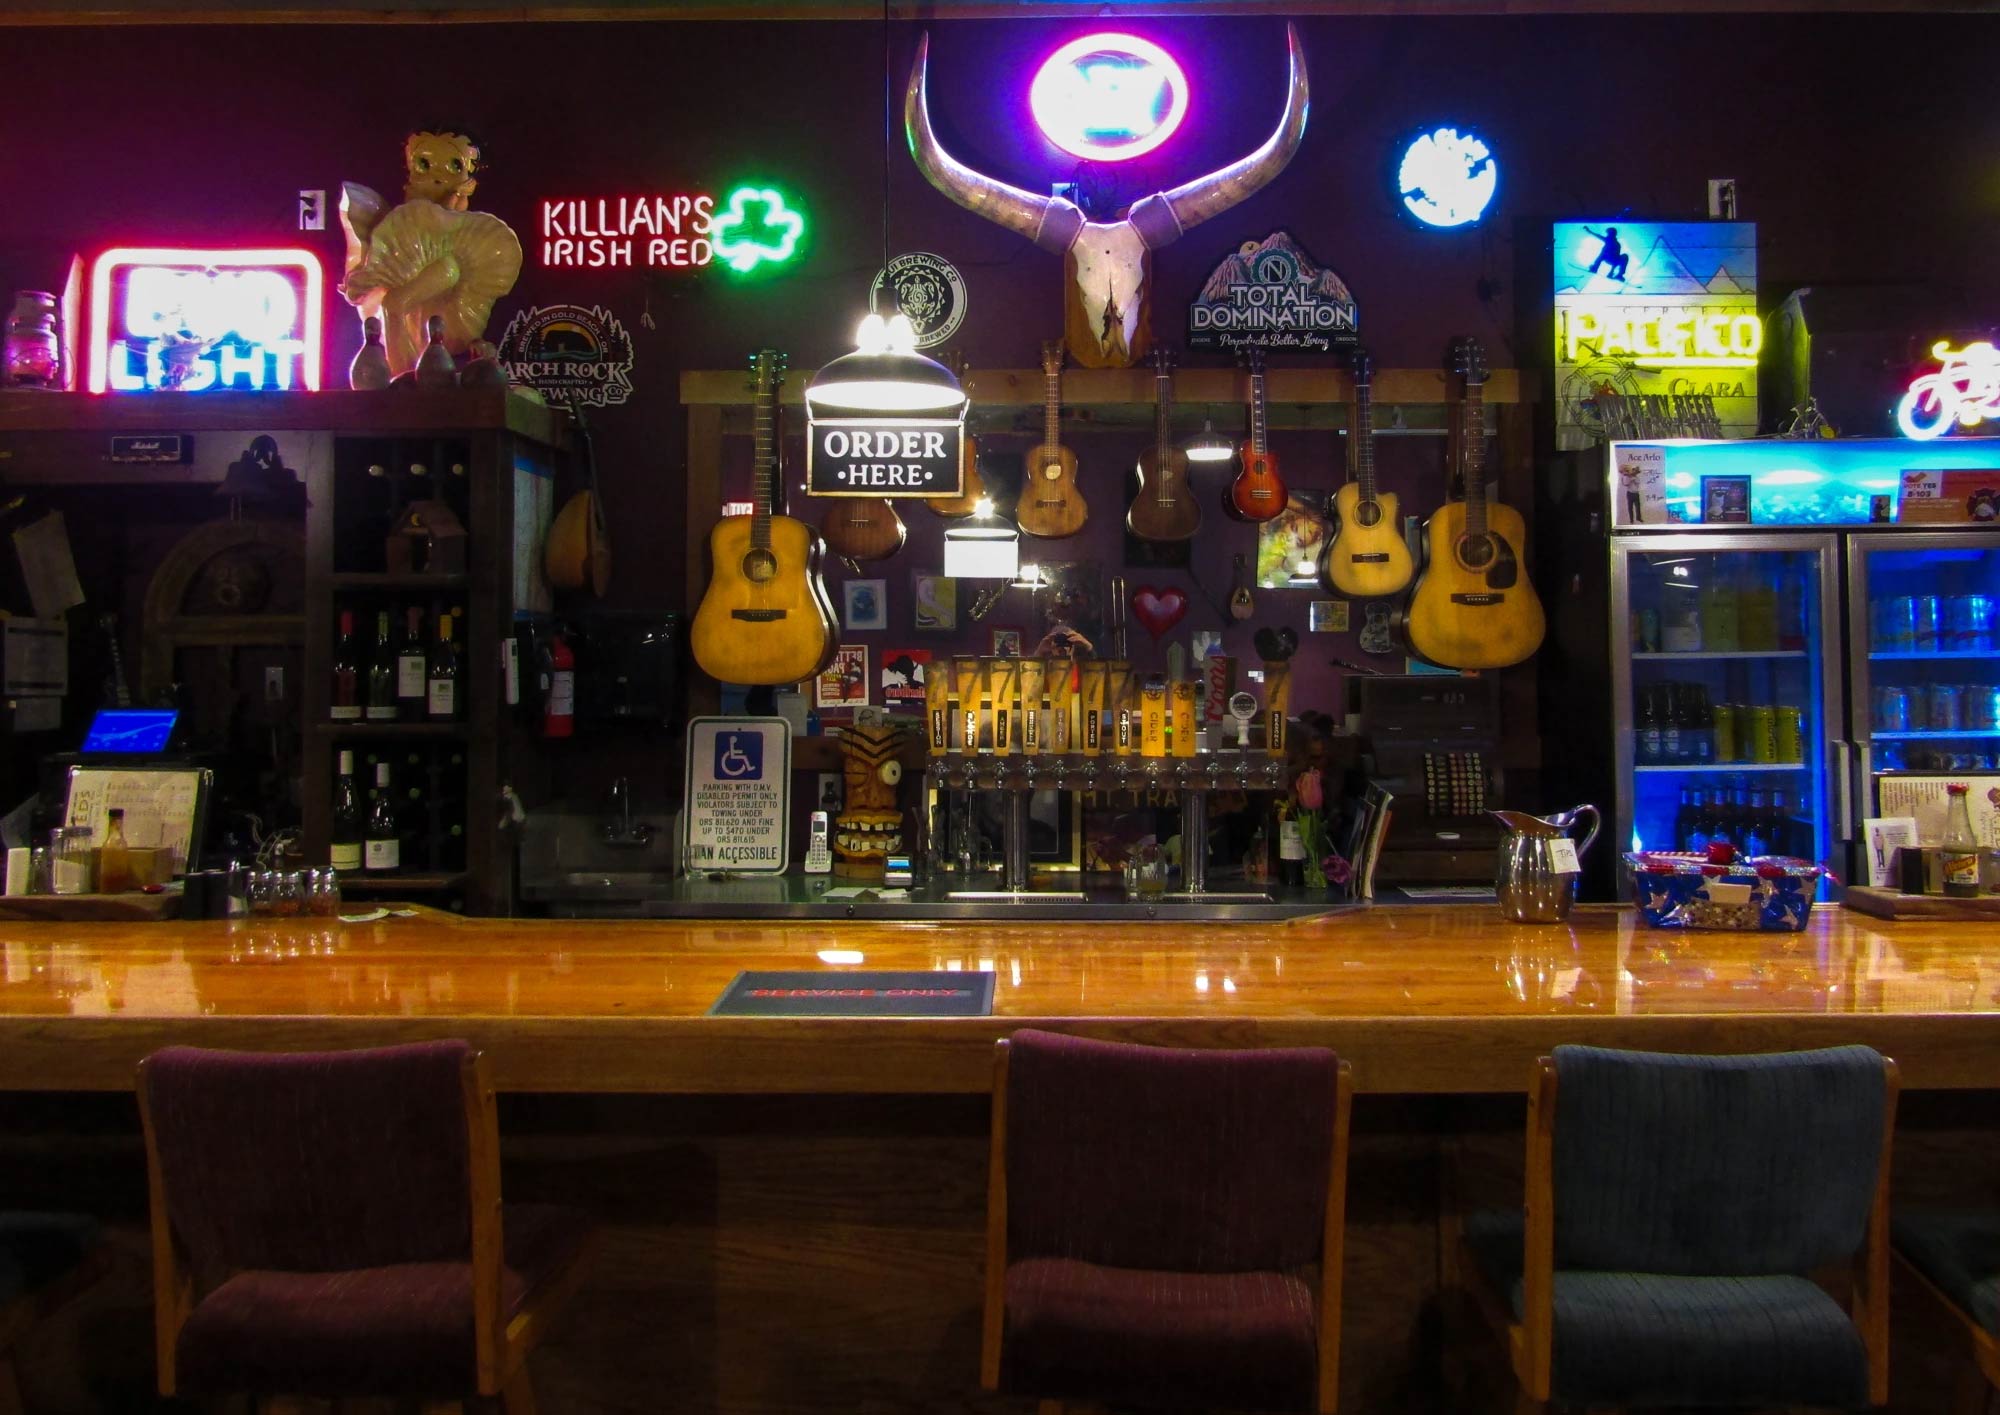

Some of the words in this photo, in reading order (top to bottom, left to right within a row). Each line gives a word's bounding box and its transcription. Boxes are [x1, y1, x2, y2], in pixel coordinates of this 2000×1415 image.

[543, 195, 714, 237] KILLIAN'S
[543, 239, 633, 267] IRISH
[648, 239, 713, 267] RED
[899, 256, 946, 272] BREWING
[1230, 285, 1317, 306] TOTAL
[542, 314, 551, 324] IN
[551, 310, 576, 320] GOLD
[1192, 305, 1354, 328] DOMINATION
[919, 324, 952, 344] BREWED
[1270, 333, 1300, 347] Better
[503, 361, 560, 382] ARCH
[564, 361, 626, 384] ROCK
[823, 430, 947, 458] ORDER
[848, 464, 923, 486] HERE
[1088, 714, 1096, 744] PORTER
[1120, 712, 1129, 744] STOUT
[1150, 711, 1159, 742] CIDER
[703, 783, 733, 791] PARKING
[735, 783, 751, 791] WITH
[697, 792, 730, 800] DISABLED
[732, 792, 757, 800] PERMIT
[759, 792, 778, 800] ONLY
[697, 801, 735, 809] VIOLATORS
[736, 801, 767, 809] SUBJECT
[712, 809, 737, 817] TOWING
[739, 809, 763, 817] UNDER
[700, 818, 713, 826] ORS
[742, 818, 756, 826] AND
[758, 818, 775, 826] FINE
[702, 827, 713, 835] UP
[715, 827, 724, 835] TO
[746, 827, 770, 835] UNDER
[716, 835, 731, 844] ORS
[718, 846, 778, 860] ACCESSIBLE
[751, 989, 876, 997] SERVICE
